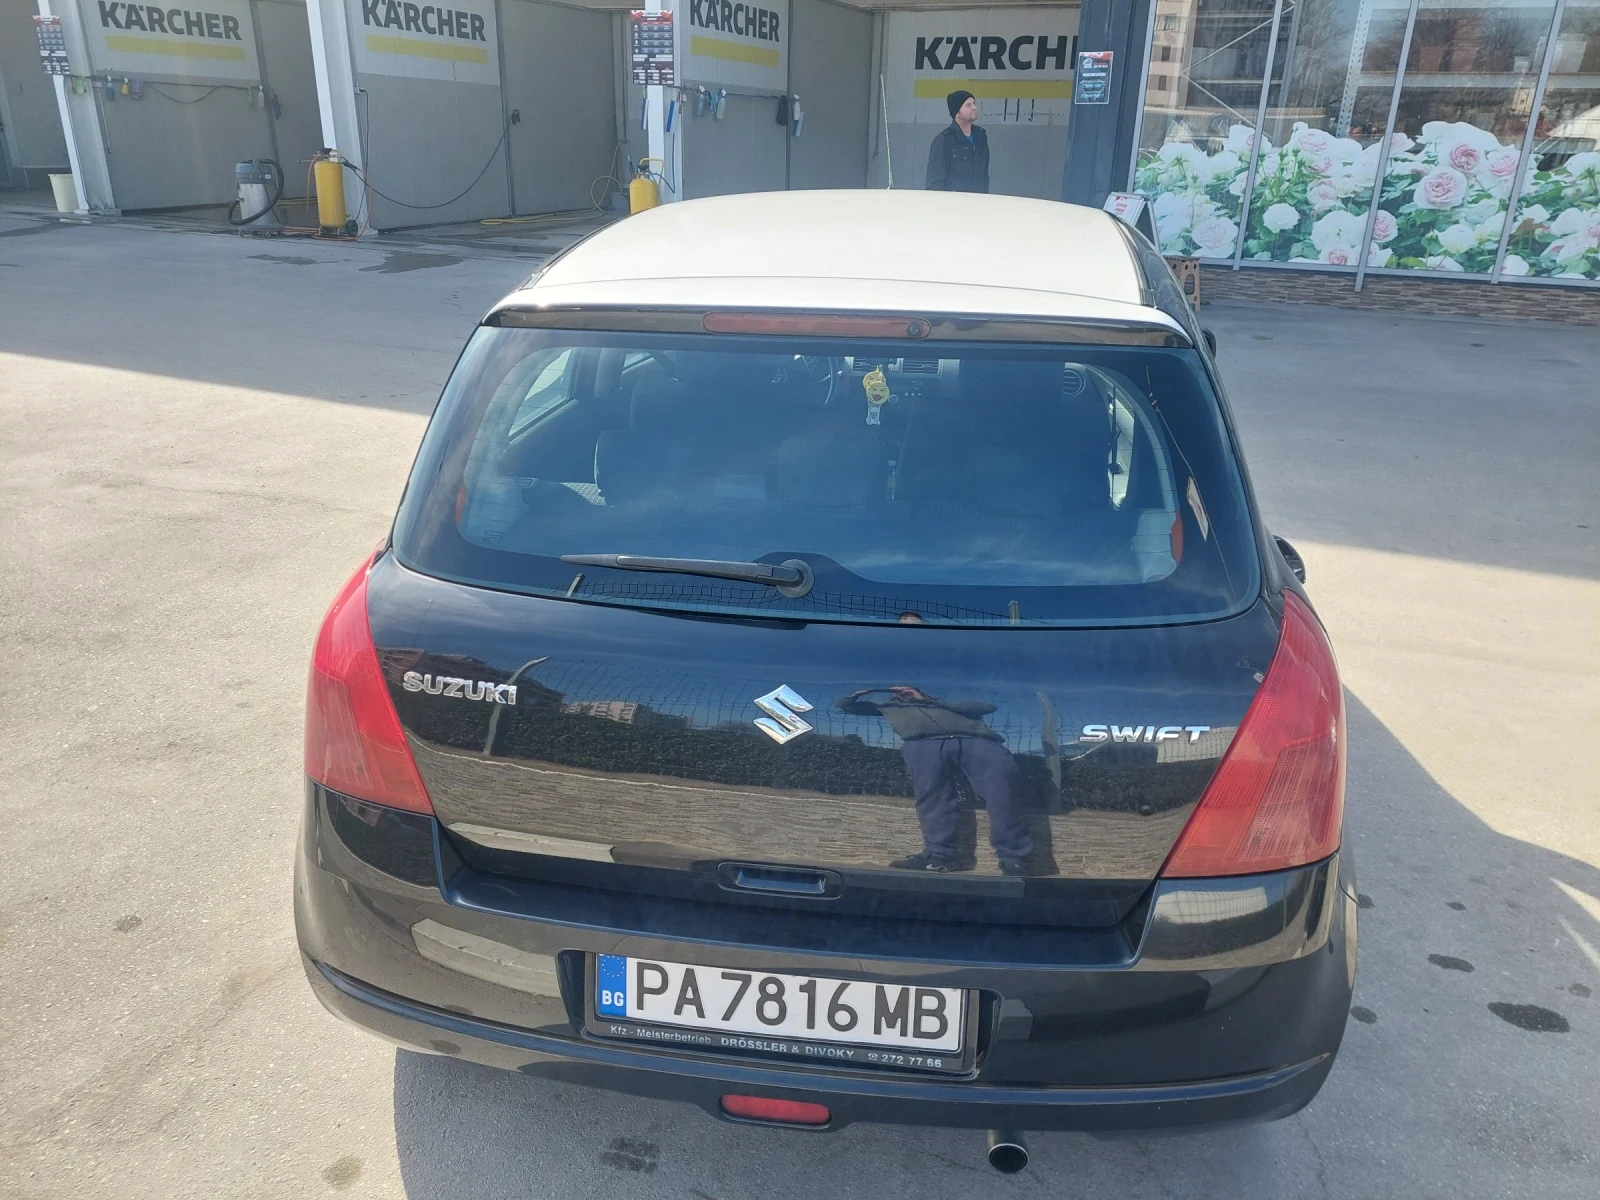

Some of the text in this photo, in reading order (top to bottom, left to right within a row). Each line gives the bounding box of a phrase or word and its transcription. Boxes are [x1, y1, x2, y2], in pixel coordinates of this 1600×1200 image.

[98, 0, 242, 41] KÄRCHER
[362, 0, 487, 42] KÄRCHER
[690, 0, 780, 42] KÄRCHER
[914, 35, 1079, 71] KÄRCH
[402, 671, 518, 706] SUZUKI
[1079, 724, 1211, 744] SWIFT
[601, 989, 625, 1007] BG
[720, 971, 859, 1033] 7816
[873, 984, 949, 1040] MB
[610, 1025, 627, 1036] Kfz
[636, 1028, 712, 1045] Meisterbetrieb
[720, 1037, 787, 1053] DRÖSSLER
[791, 1045, 800, 1054] &
[805, 1046, 855, 1059] DIVOKY
[881, 1054, 904, 1065] 272
[909, 1057, 923, 1066] 77
[926, 1058, 942, 1068] 66
